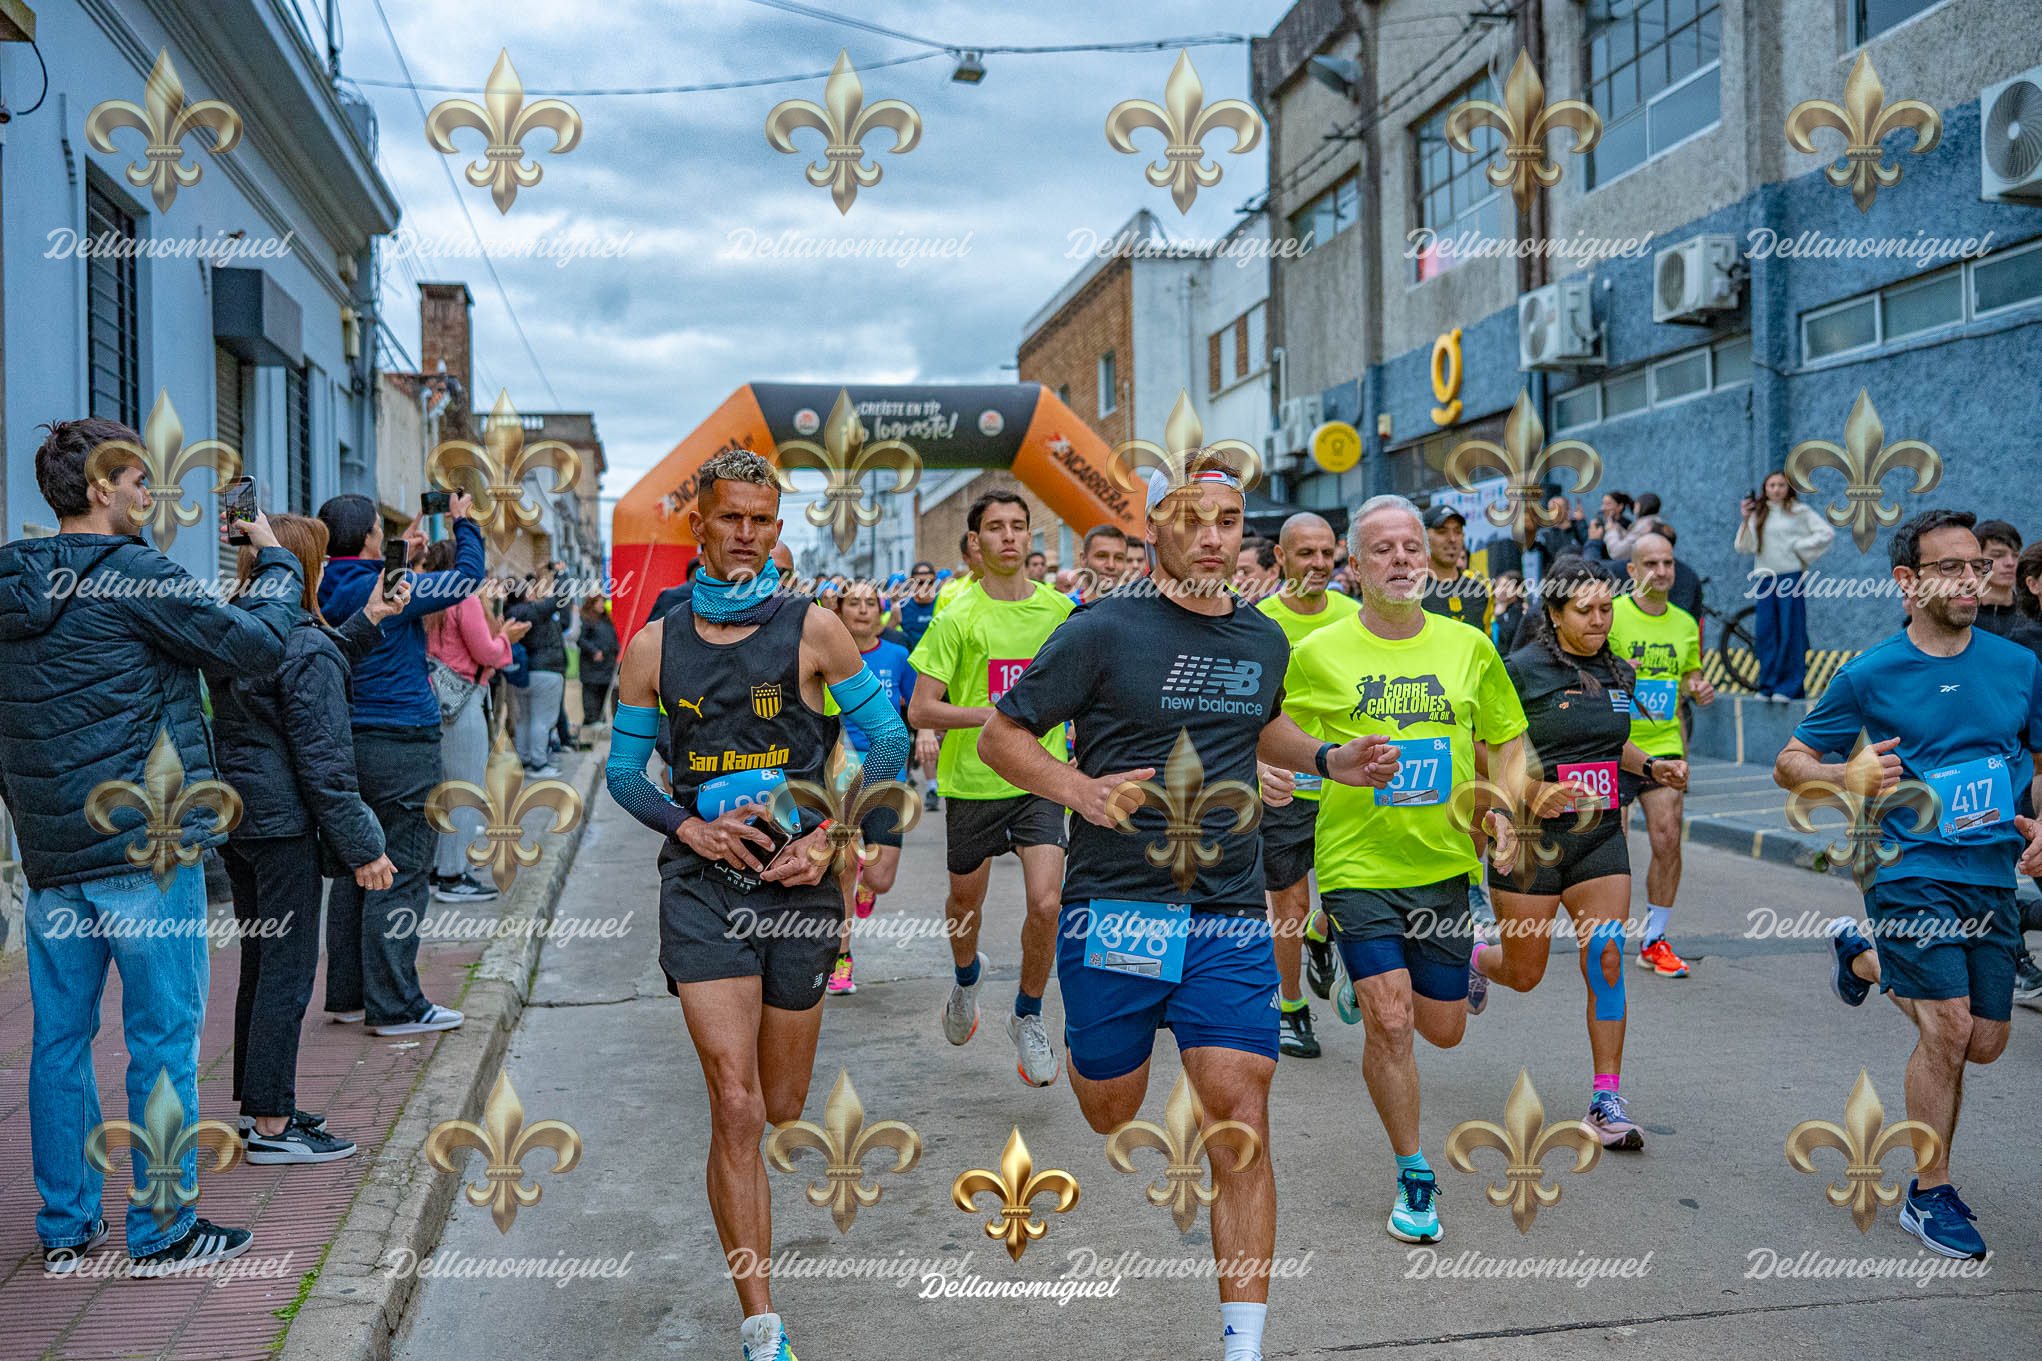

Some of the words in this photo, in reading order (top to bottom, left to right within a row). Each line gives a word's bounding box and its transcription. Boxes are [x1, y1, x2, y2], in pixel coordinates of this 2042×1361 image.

[1384, 682, 1429, 699] CORRE
[1637, 691, 1669, 712] 369
[1160, 695, 1195, 711] new
[1198, 695, 1263, 716] balance
[1366, 695, 1446, 715] CANELONES
[688, 752, 719, 772] San
[722, 744, 790, 771] Ramón
[1388, 758, 1439, 790] 377
[1567, 768, 1612, 796] 208
[1951, 777, 1994, 813] 417
[1101, 913, 1168, 956] 398
